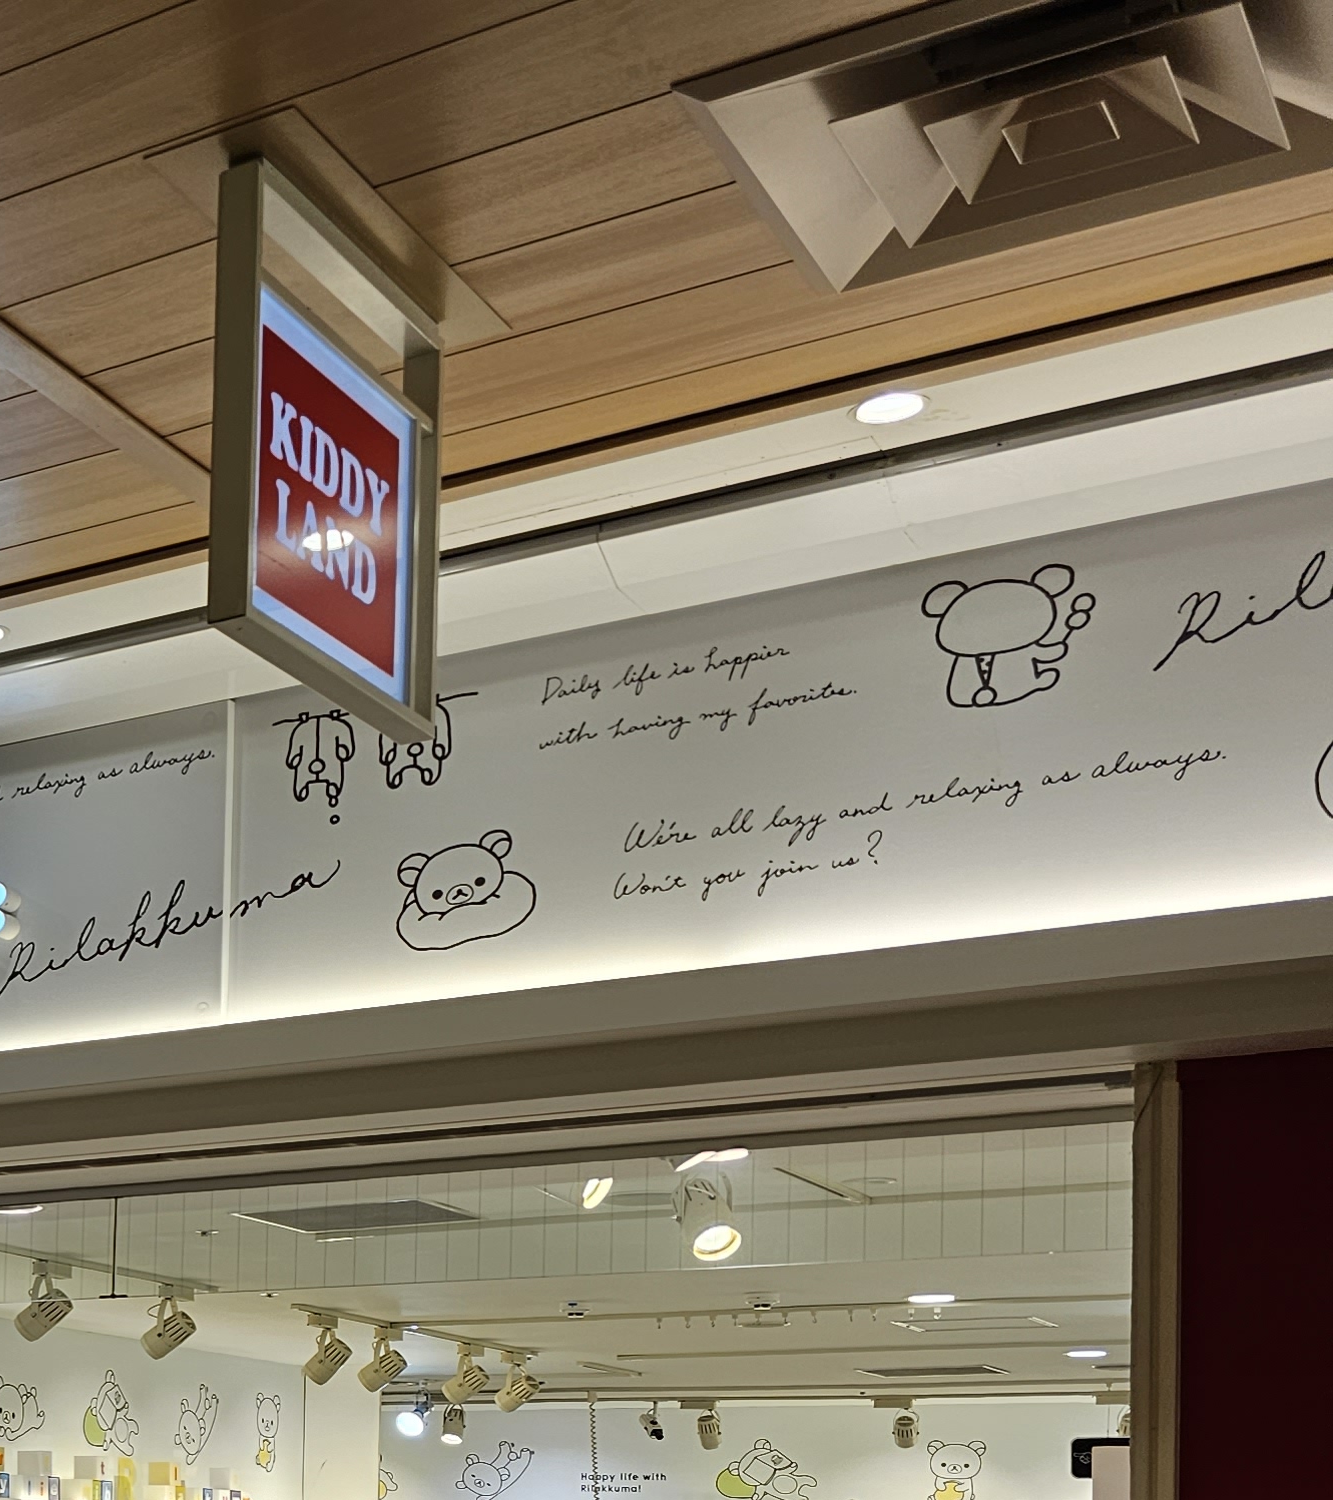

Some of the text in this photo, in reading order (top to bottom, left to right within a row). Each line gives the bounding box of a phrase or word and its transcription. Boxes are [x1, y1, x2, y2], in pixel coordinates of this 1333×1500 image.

[269, 391, 390, 536] KIDDY
[275, 479, 377, 606] LAND
[541, 642, 791, 706] Daily life is happier
[537, 722, 598, 750] with
[608, 708, 693, 744] having
[699, 706, 738, 729] my
[12, 773, 88, 800] relaxing
[97, 768, 122, 781] as
[624, 820, 698, 857] We're
[710, 804, 758, 842] all
[768, 795, 829, 853] lazy
[838, 787, 892, 822] and
[906, 769, 1024, 816] relaxing
[1039, 763, 1078, 786] as
[612, 830, 884, 905] Won't you join us?
[581, 1472, 667, 1483] Happy life with
